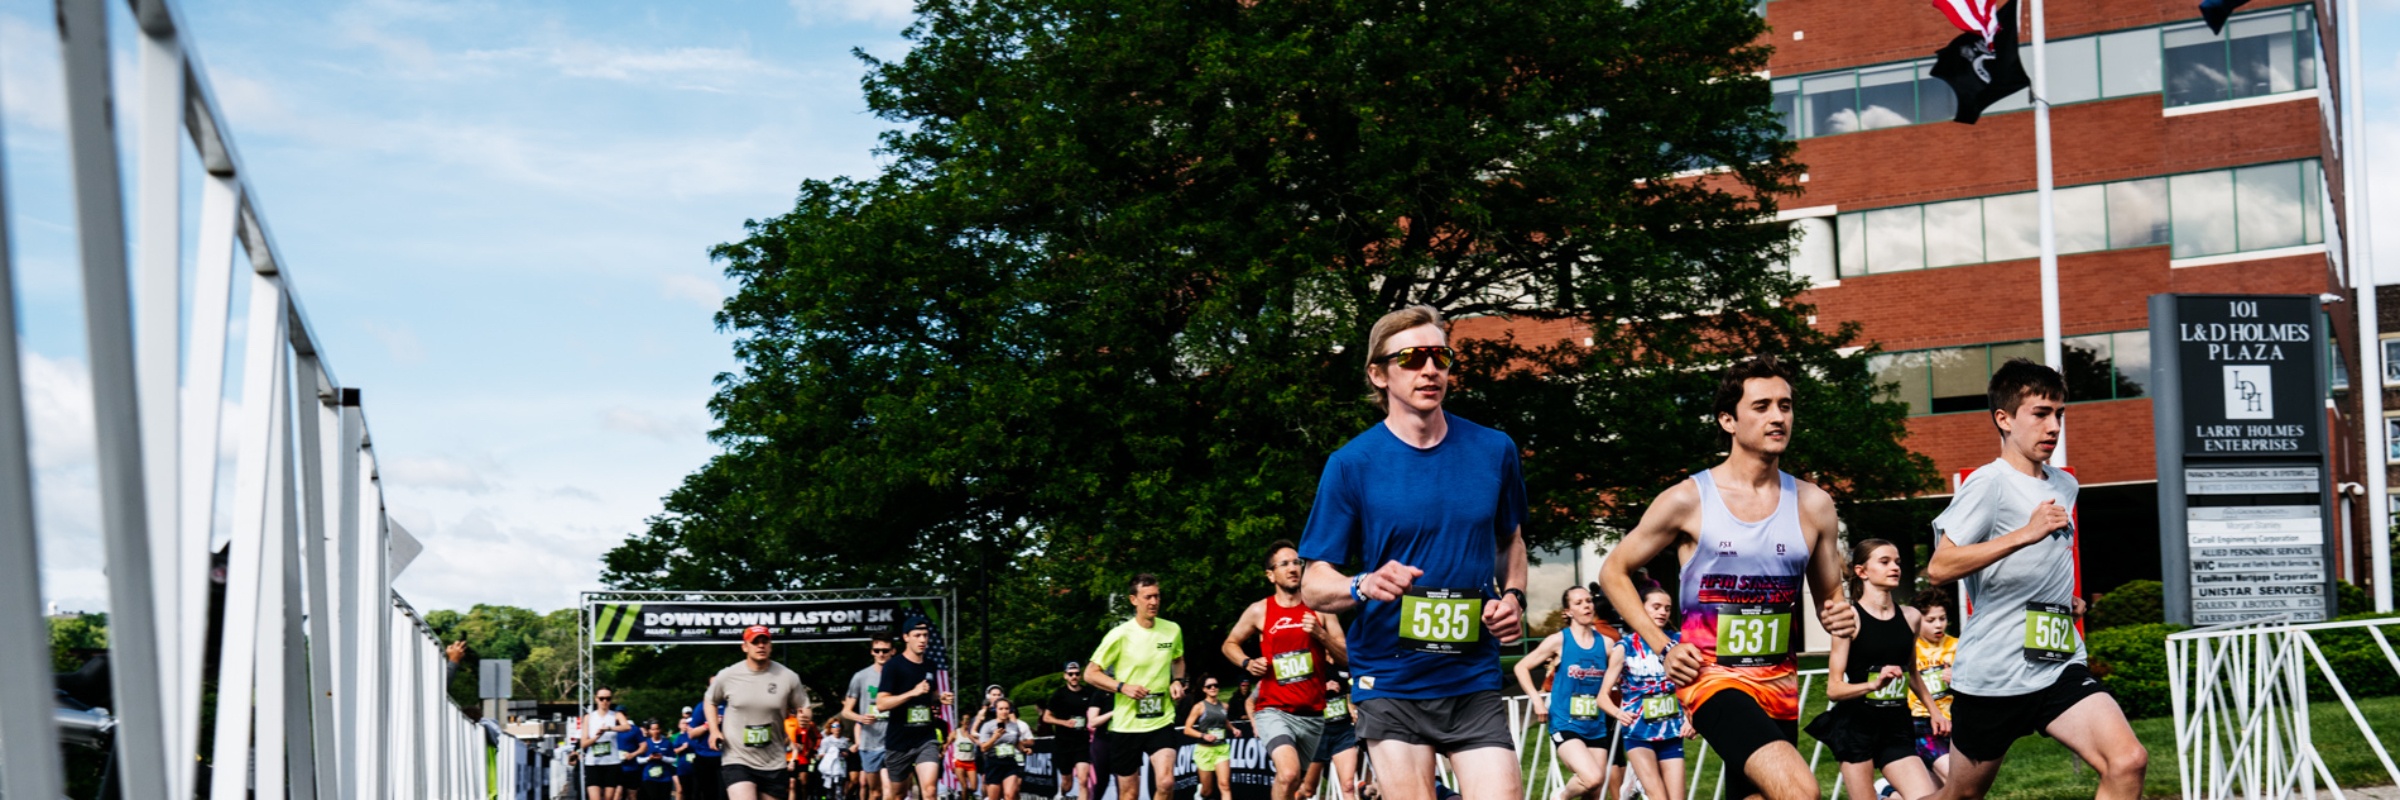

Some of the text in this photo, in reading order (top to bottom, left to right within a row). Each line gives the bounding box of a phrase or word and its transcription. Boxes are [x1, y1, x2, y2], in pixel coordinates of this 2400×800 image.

[2229, 301, 2258, 318] 101
[2230, 323, 2310, 342] HOLMES
[2208, 344, 2285, 360] PLAZA
[2196, 425, 2304, 438] LARRY HOLMES
[2204, 439, 2298, 451] ENTERPRISES
[2192, 535, 2299, 545] Carroll Engineering Corporation
[2201, 548, 2312, 557] ALLIED PERSONNEL SERVICES
[2193, 561, 2215, 570] WIC
[1700, 574, 1738, 589] FIFTH
[2197, 573, 2318, 583] EquiHome Mortgage Corporation
[2199, 586, 2316, 597] UNISTAR SERVICES
[644, 608, 894, 626] DOWNTOWN EASTON 5K
[1412, 601, 1470, 640] 535
[2196, 614, 2237, 622] JARROD
[1728, 618, 1779, 654] 531
[2035, 615, 2070, 650] 562
[1280, 655, 1309, 678] 504
[1140, 698, 1162, 714] 534
[1326, 700, 1346, 717] 533
[1574, 696, 1597, 715] 513
[1648, 697, 1674, 717] 540
[748, 729, 768, 743] 570
